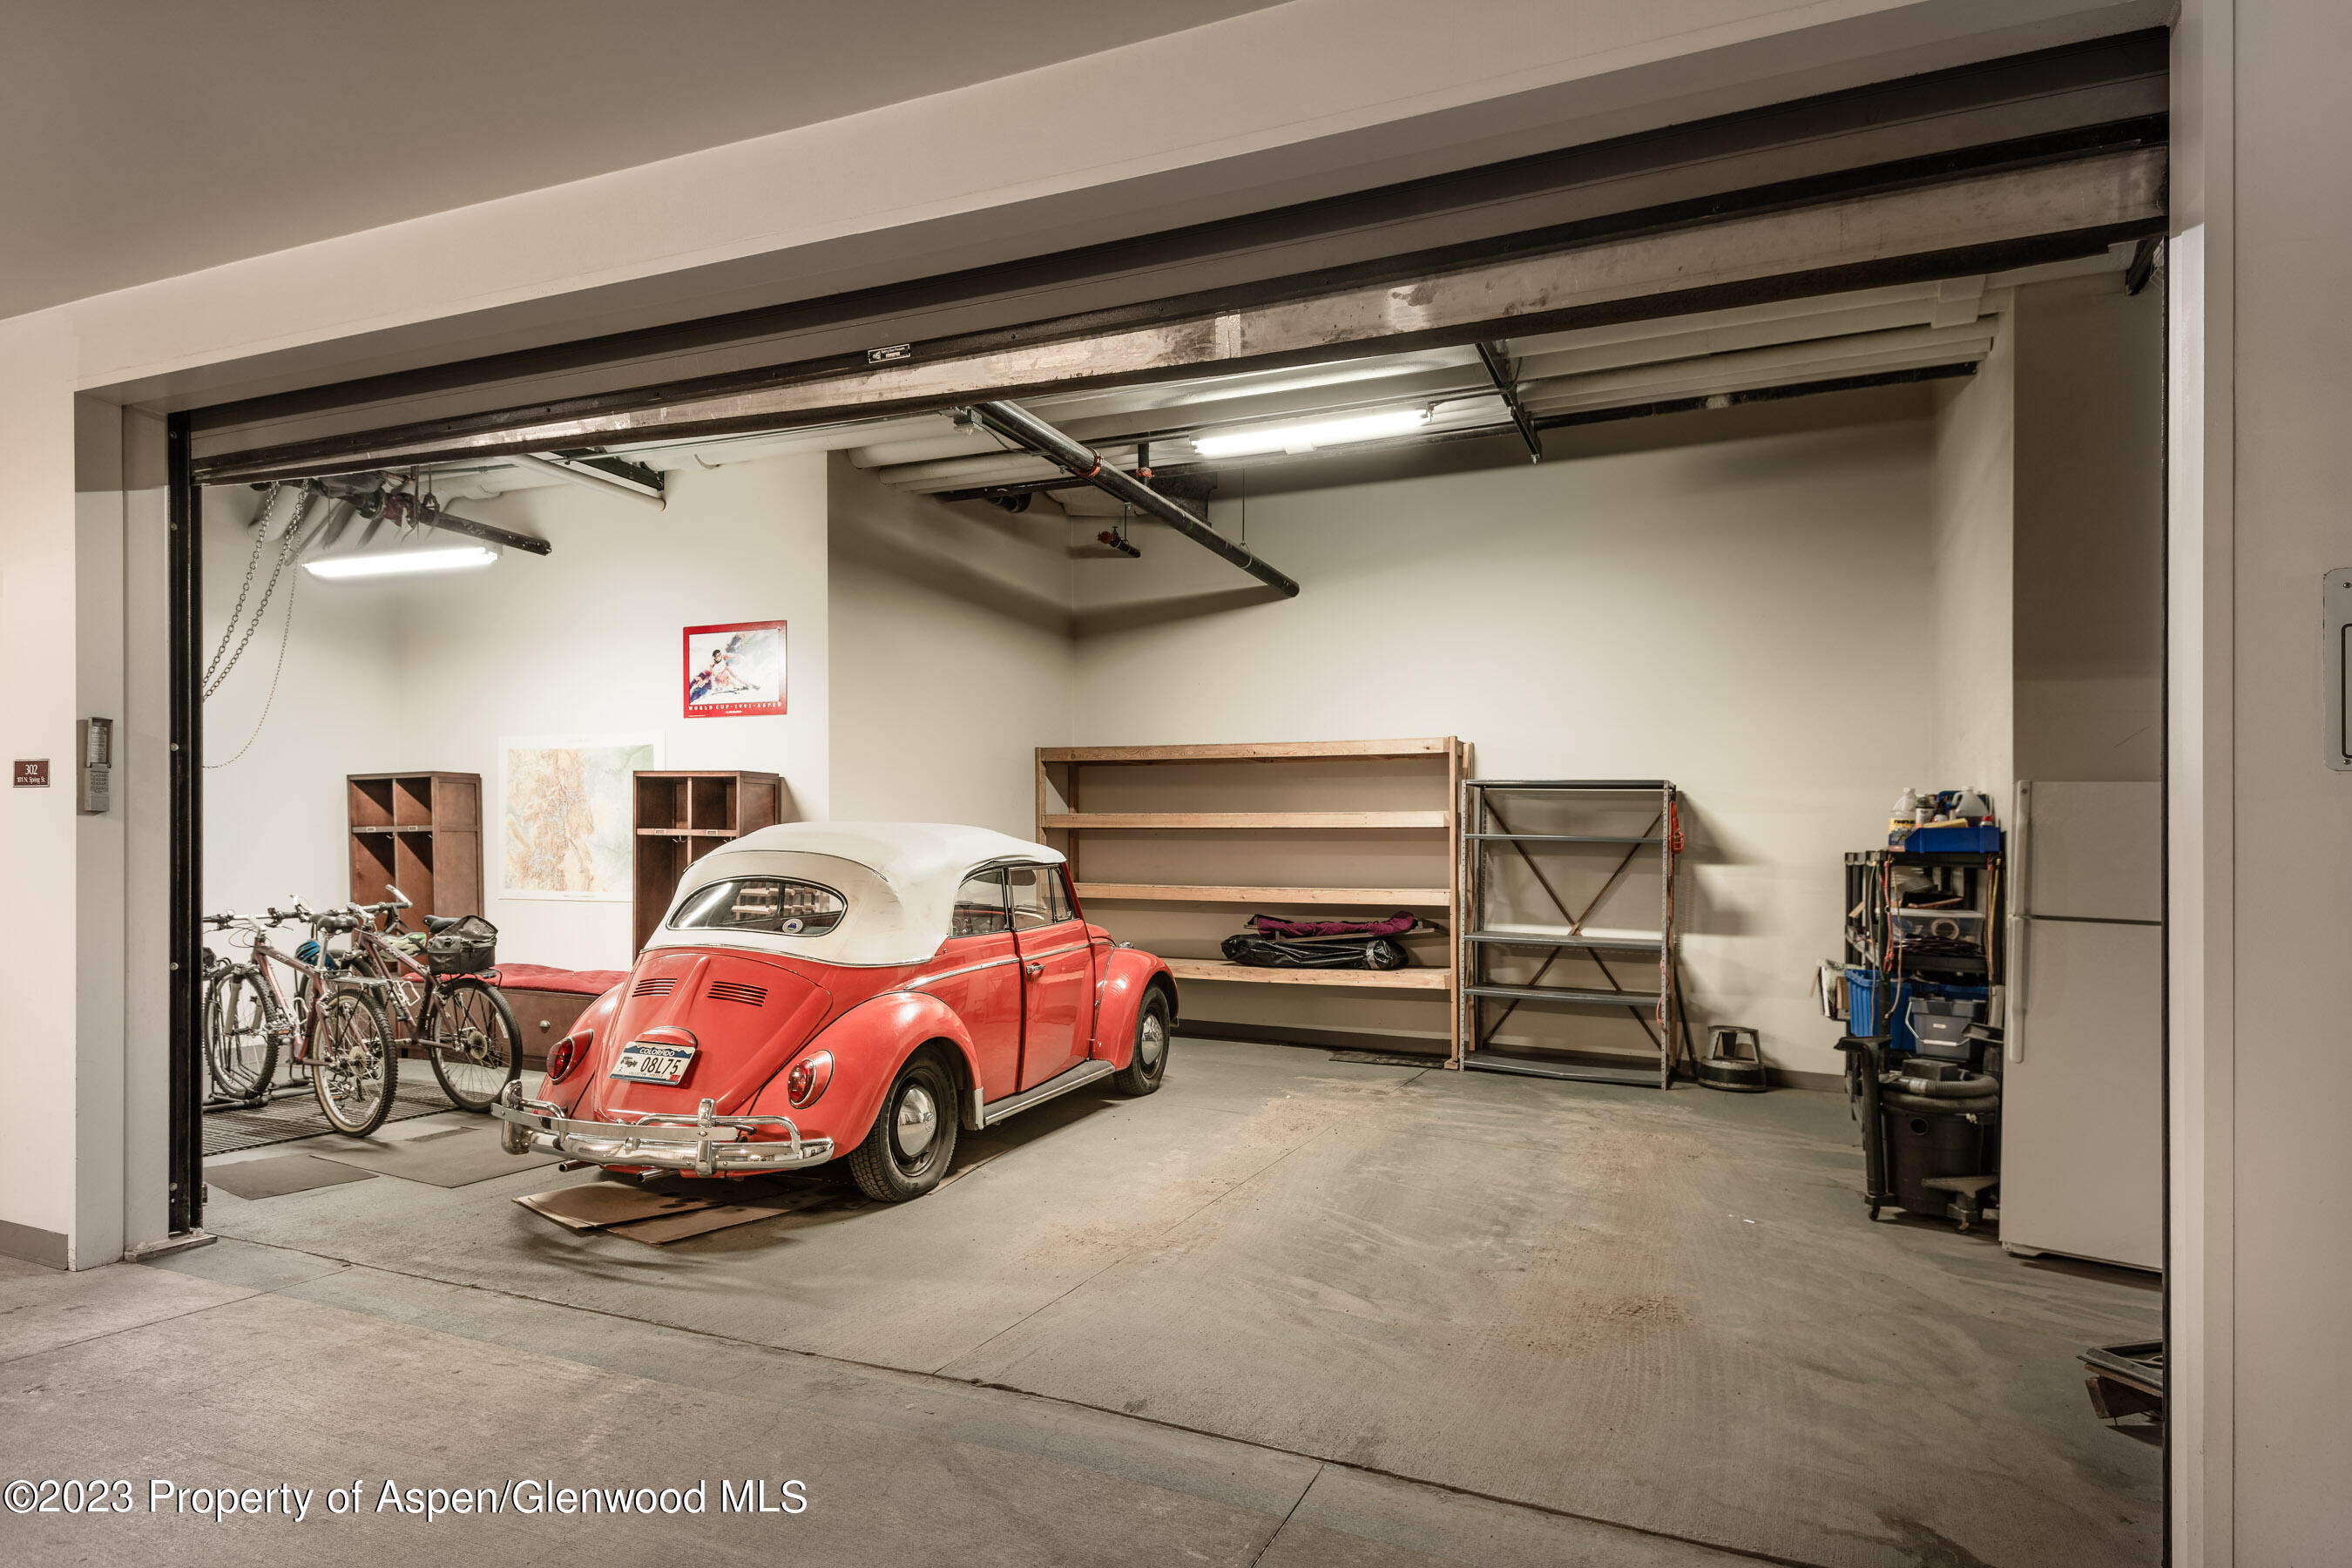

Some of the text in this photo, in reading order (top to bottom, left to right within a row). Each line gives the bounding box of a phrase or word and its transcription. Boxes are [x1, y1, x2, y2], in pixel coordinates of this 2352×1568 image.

[25, 764, 38, 775] 302
[639, 1047, 675, 1057] COLORADO
[640, 1057, 681, 1075] 08L75
